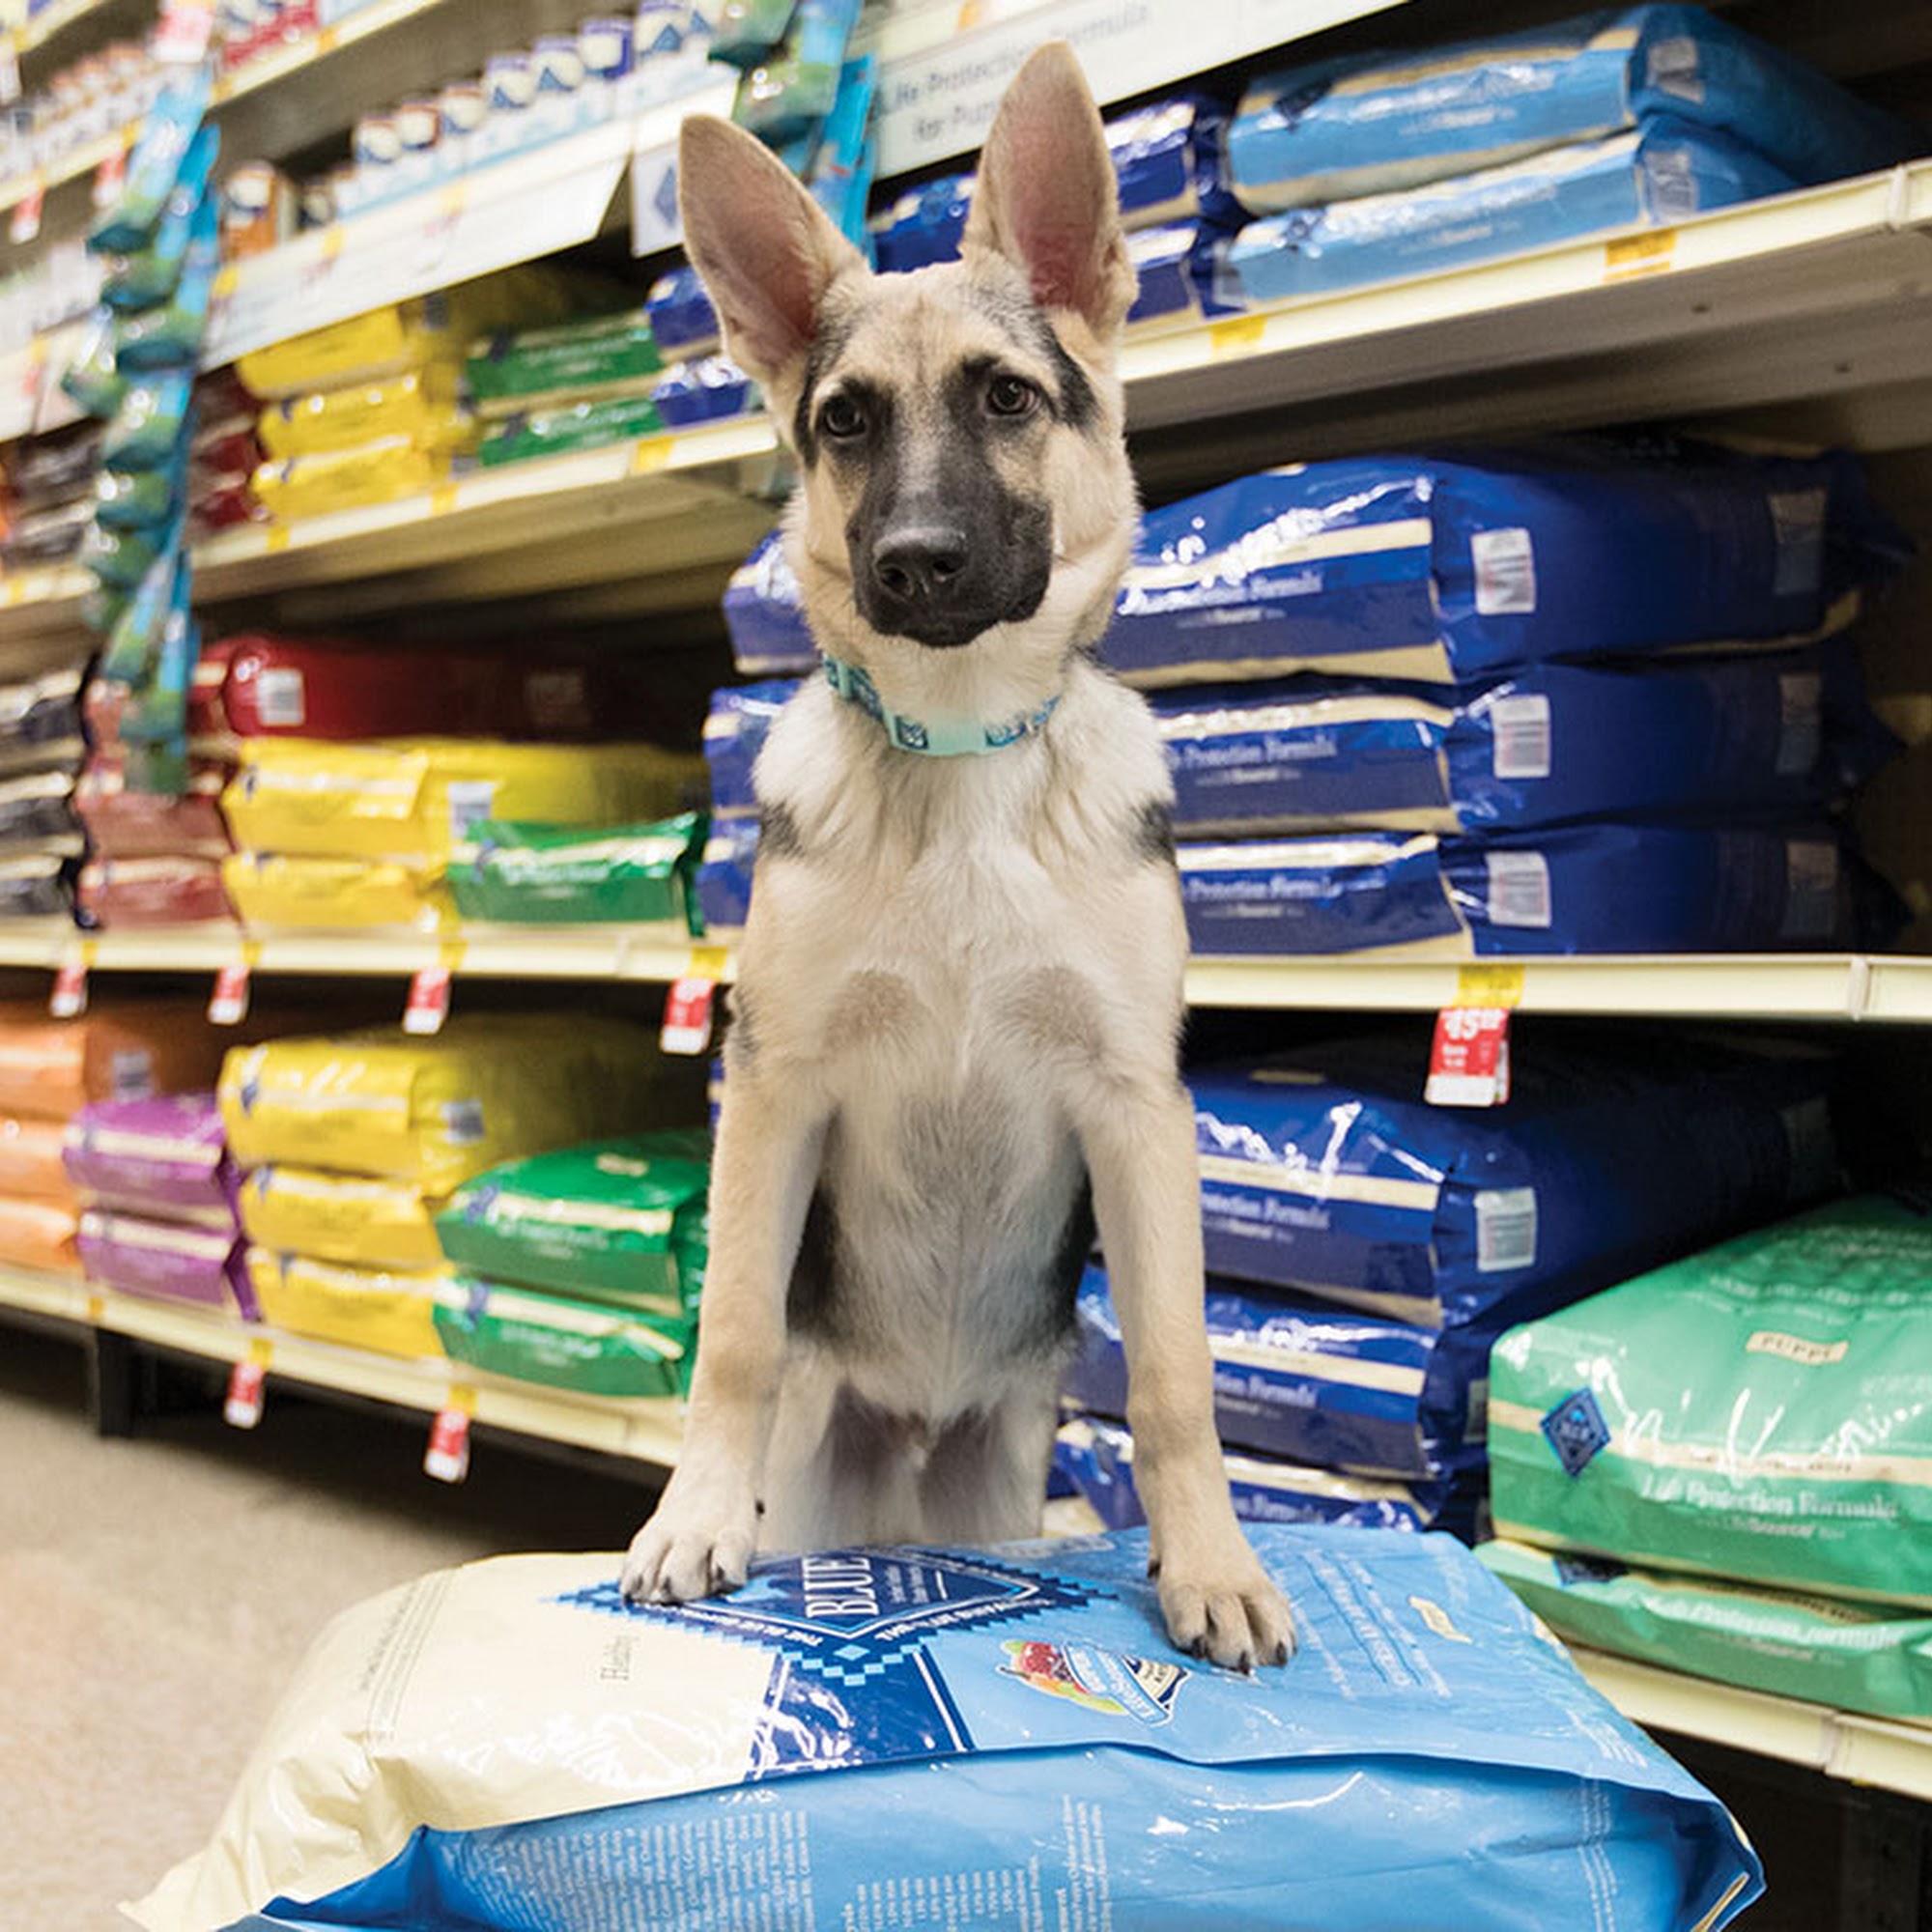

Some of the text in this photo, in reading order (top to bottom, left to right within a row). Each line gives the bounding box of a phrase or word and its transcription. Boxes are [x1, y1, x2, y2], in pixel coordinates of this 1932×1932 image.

[1686, 1480, 1794, 1517] Protection
[1798, 1490, 1898, 1520] Formula
[800, 1555, 880, 1619] BLUE
